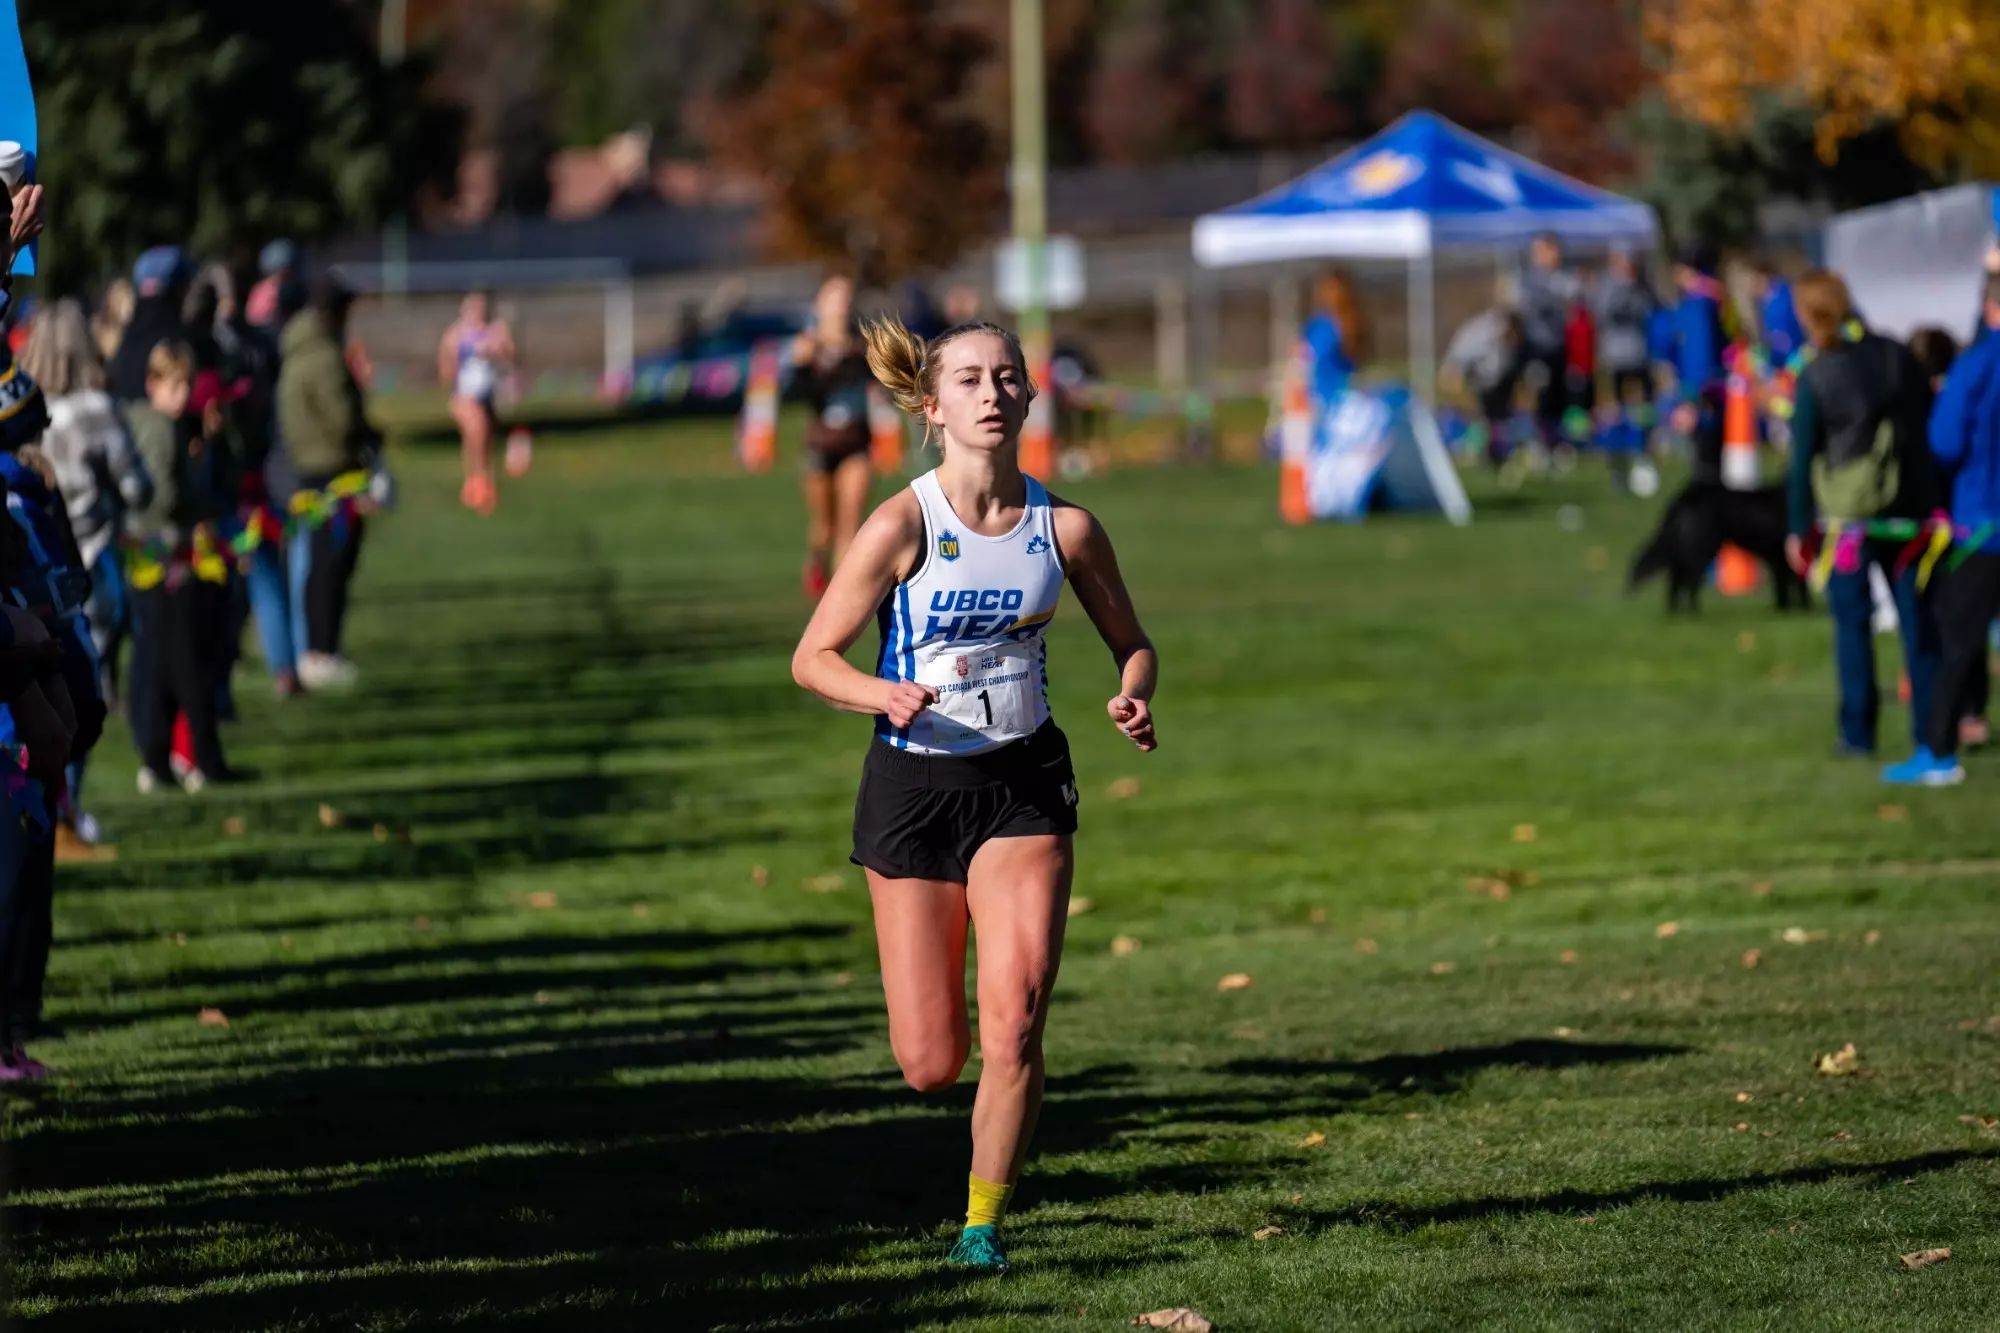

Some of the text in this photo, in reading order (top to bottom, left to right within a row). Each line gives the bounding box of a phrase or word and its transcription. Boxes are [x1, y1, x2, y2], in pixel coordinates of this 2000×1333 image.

[940, 541, 957, 556] CW
[930, 589, 1024, 612] UBCO
[947, 681, 972, 693] CANADA
[971, 678, 988, 689] WEST
[978, 689, 993, 725] 1
